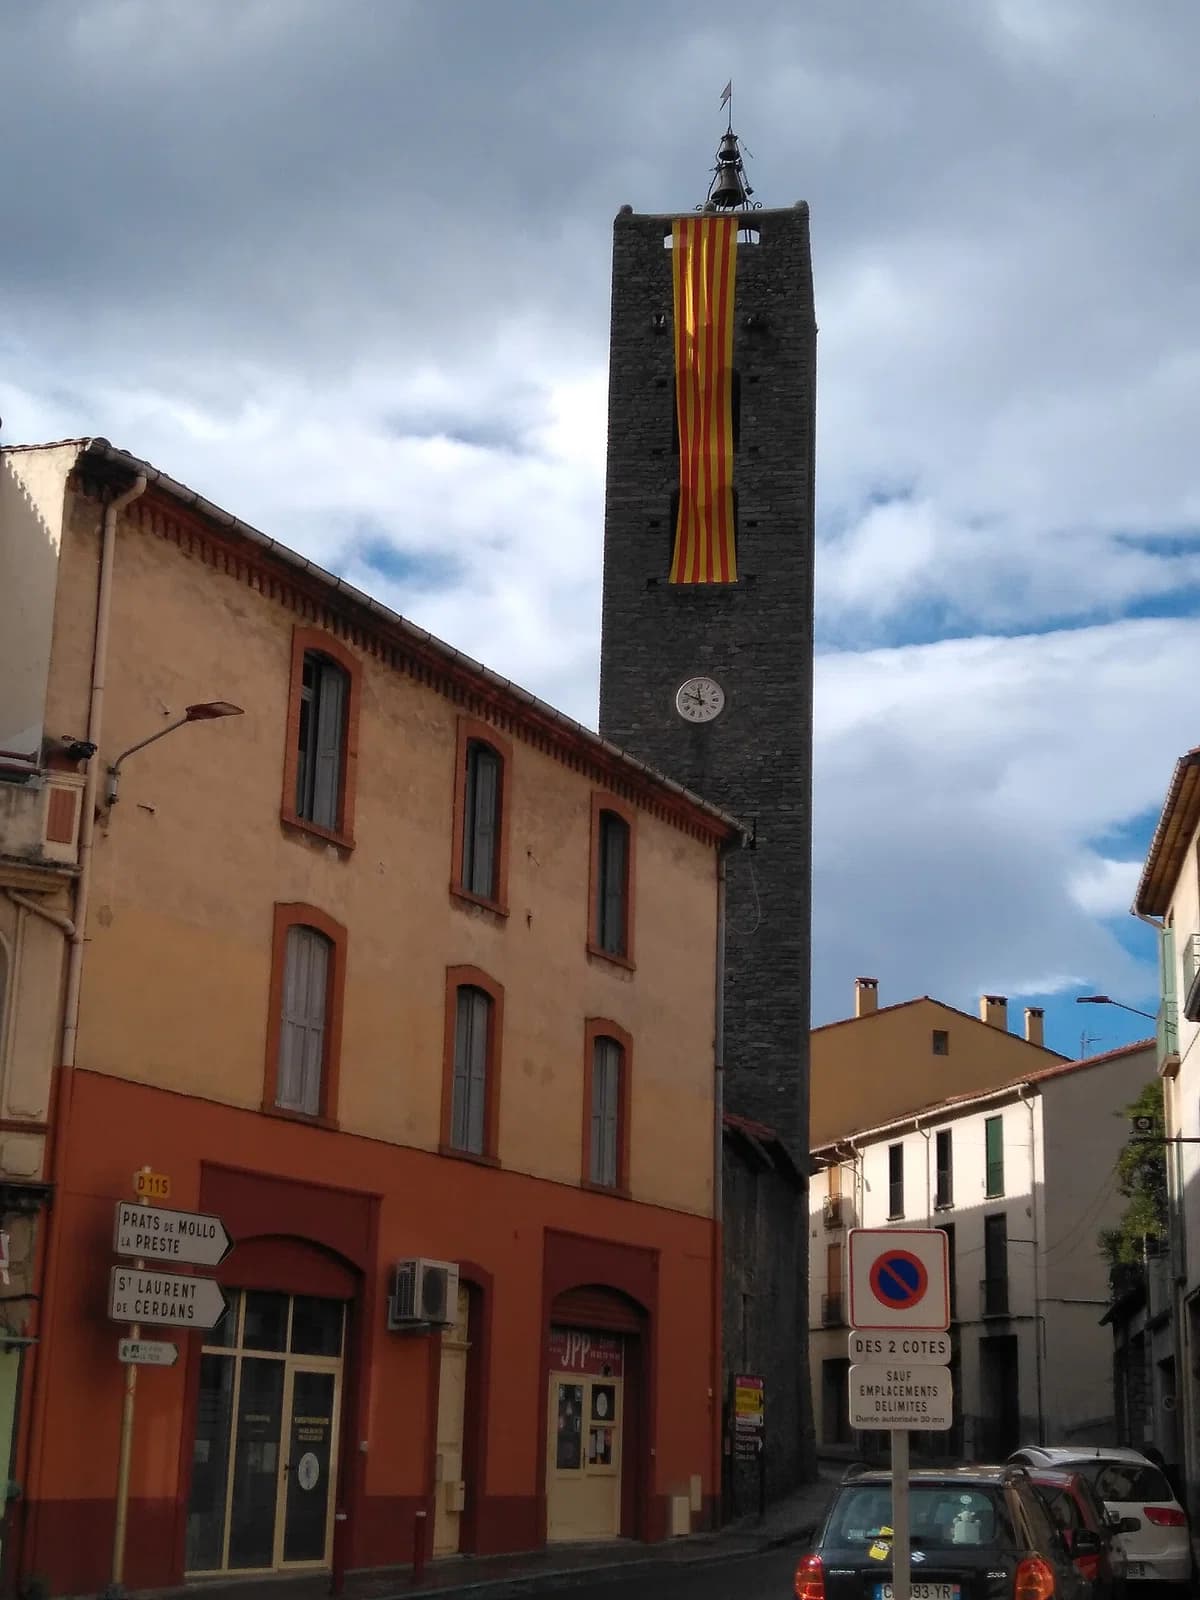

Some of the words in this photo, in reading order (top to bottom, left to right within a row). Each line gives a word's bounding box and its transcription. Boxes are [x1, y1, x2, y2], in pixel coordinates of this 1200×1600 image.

[149, 1178, 168, 1194] 115
[123, 1211, 160, 1230] PRATS
[164, 1223, 173, 1233] DE
[178, 1220, 216, 1239] MOLLO
[121, 1237, 131, 1247] LA
[136, 1234, 180, 1254] PRESTE
[138, 1279, 197, 1299] LAURENT
[116, 1303, 128, 1313] DE
[135, 1300, 194, 1319] CERDANS
[856, 1340, 882, 1353] DES
[888, 1340, 896, 1353] 2
[902, 1341, 945, 1354] COTES
[886, 1371, 912, 1382] SAUF
[860, 1385, 938, 1397] EMPLACEMENTS
[875, 1401, 927, 1412] DELIMITES
